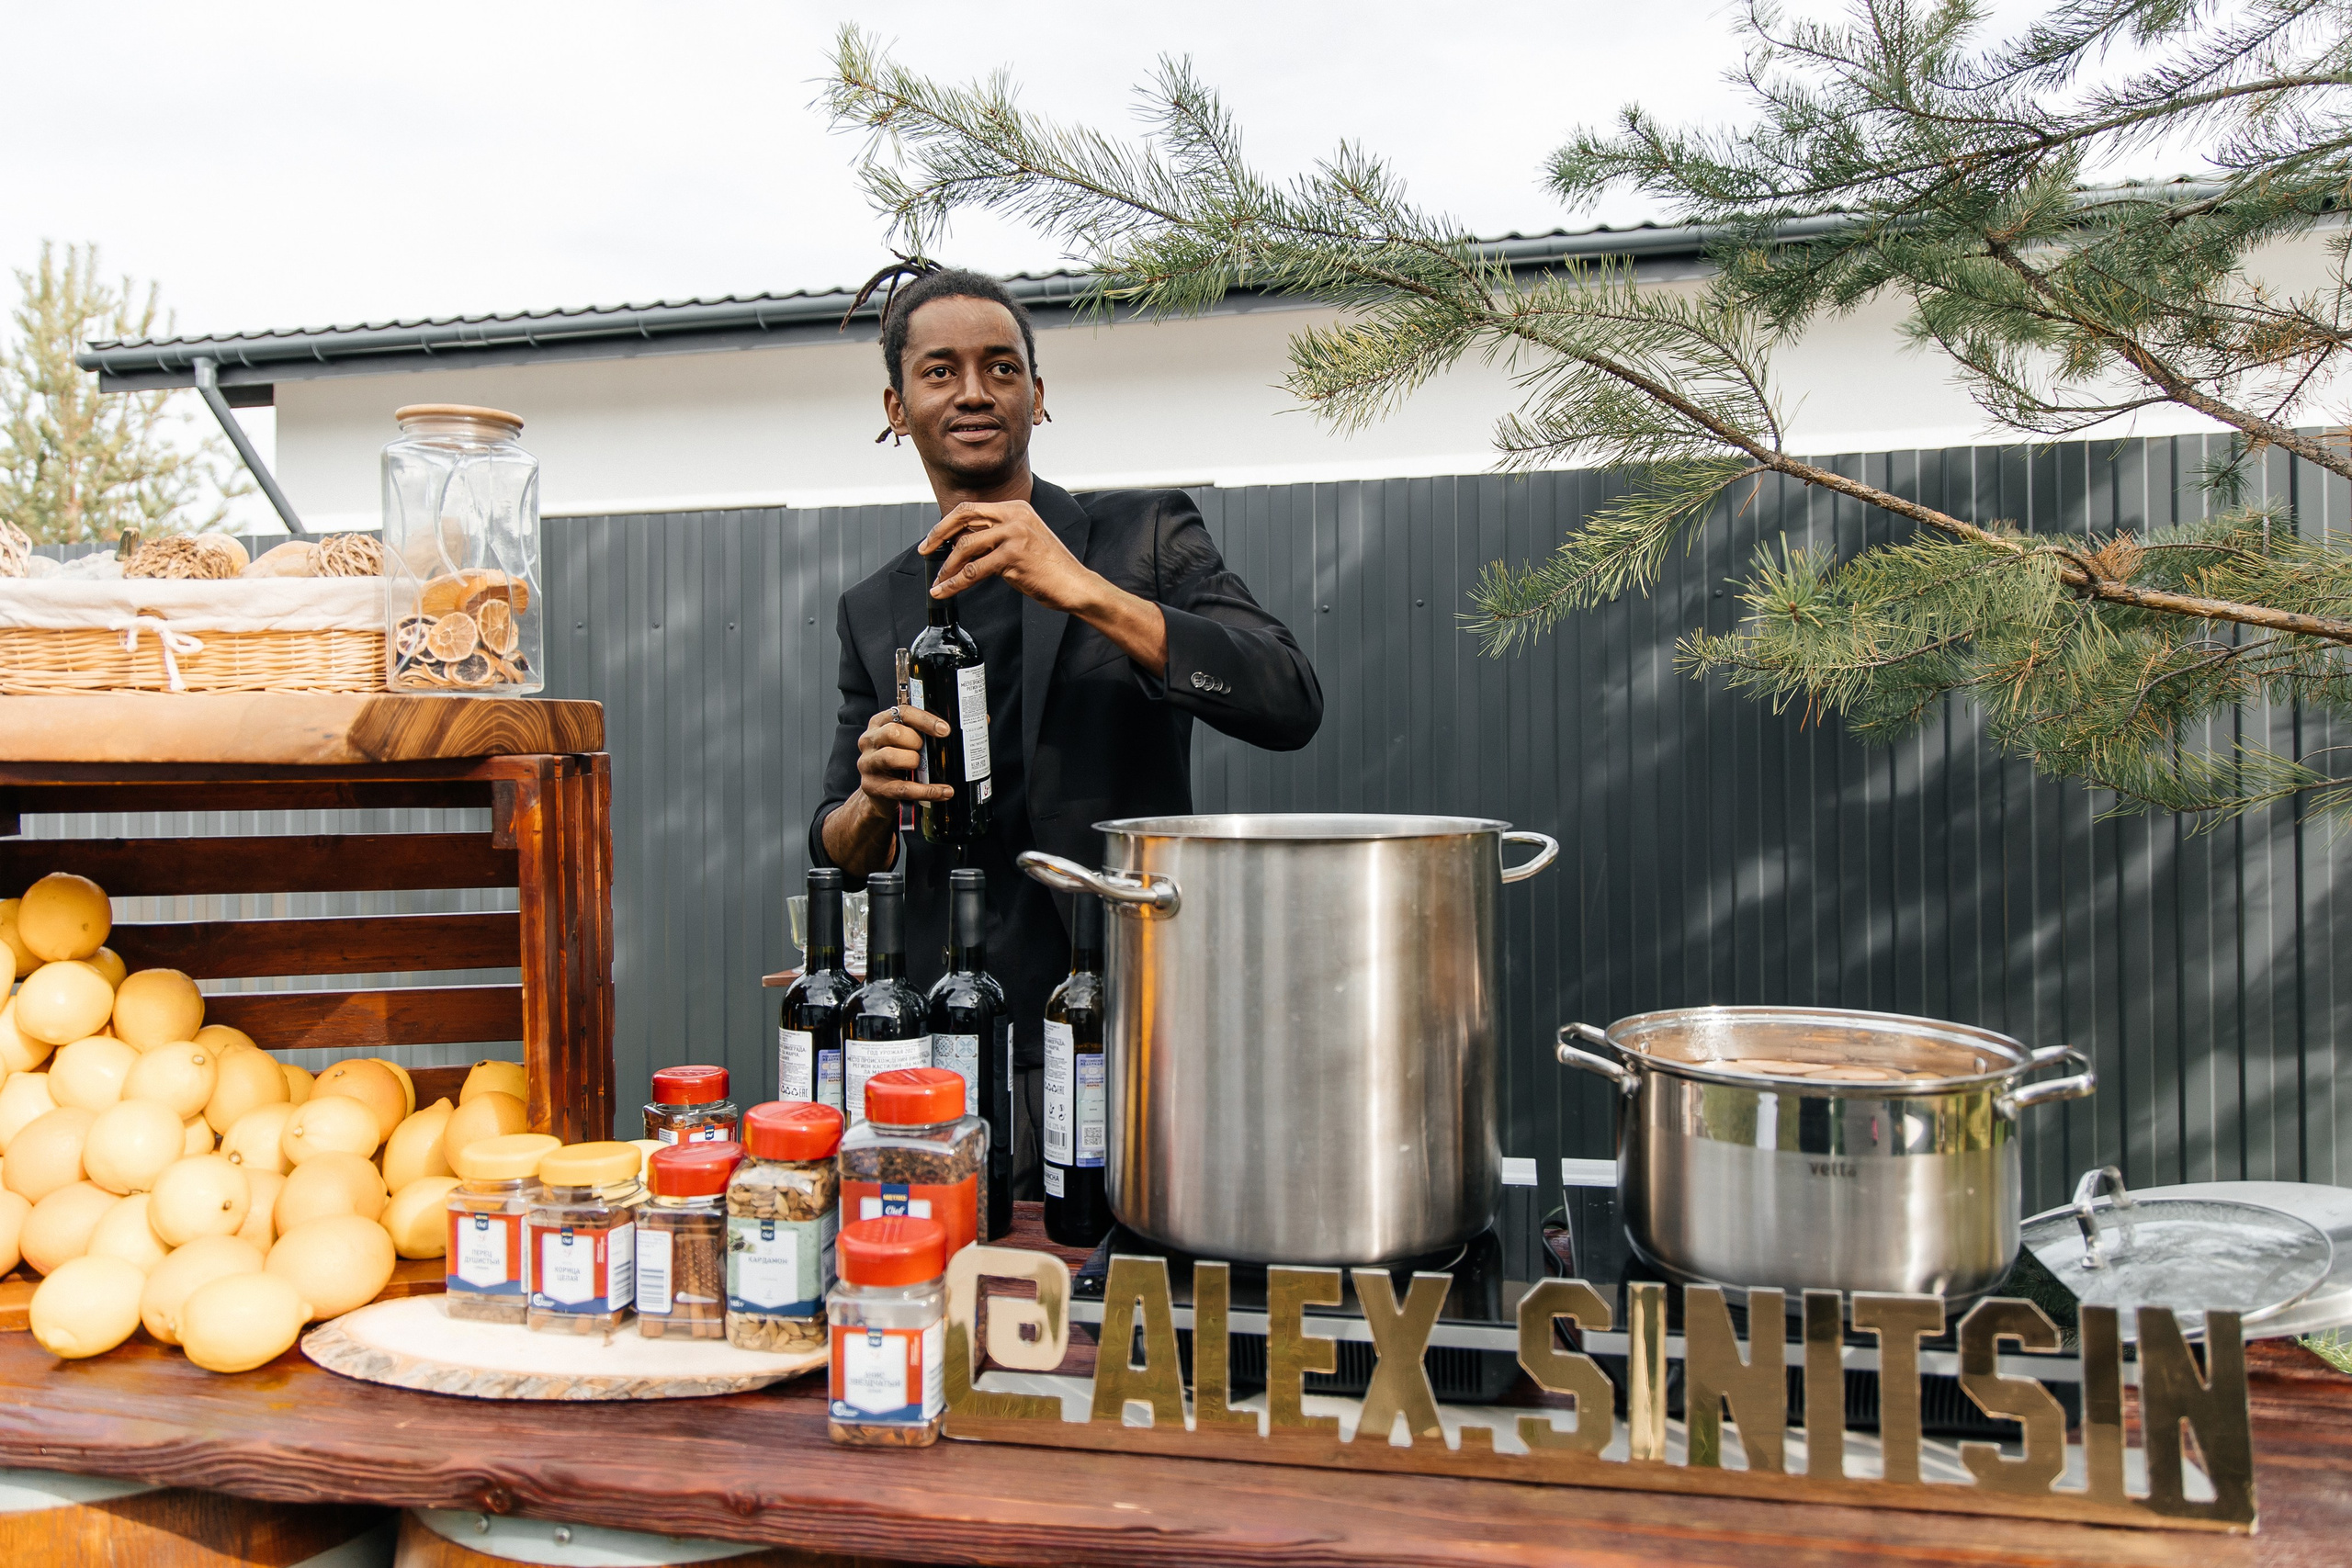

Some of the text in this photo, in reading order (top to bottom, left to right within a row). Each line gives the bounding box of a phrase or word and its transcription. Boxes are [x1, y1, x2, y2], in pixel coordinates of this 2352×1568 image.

[885, 1204, 906, 1217] Chef
[748, 1257, 787, 1265] КАРДАМОН
[554, 1267, 581, 1275] КОРИЦА
